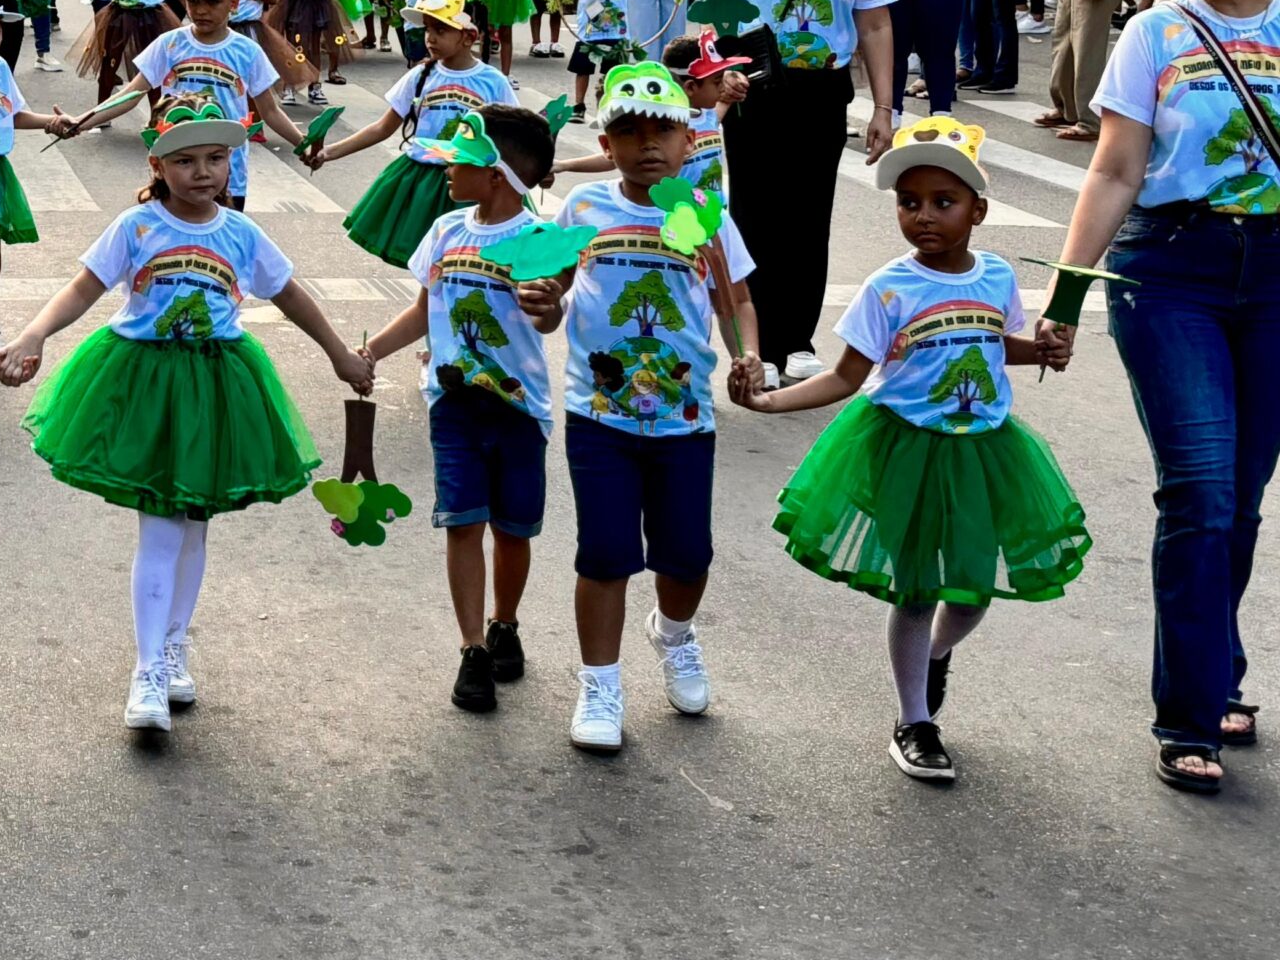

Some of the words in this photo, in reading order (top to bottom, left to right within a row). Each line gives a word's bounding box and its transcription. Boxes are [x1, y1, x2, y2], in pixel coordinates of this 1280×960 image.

[1241, 59, 1261, 70] MEIO
[1189, 81, 1216, 91] DESDE
[1218, 82, 1229, 91] OS
